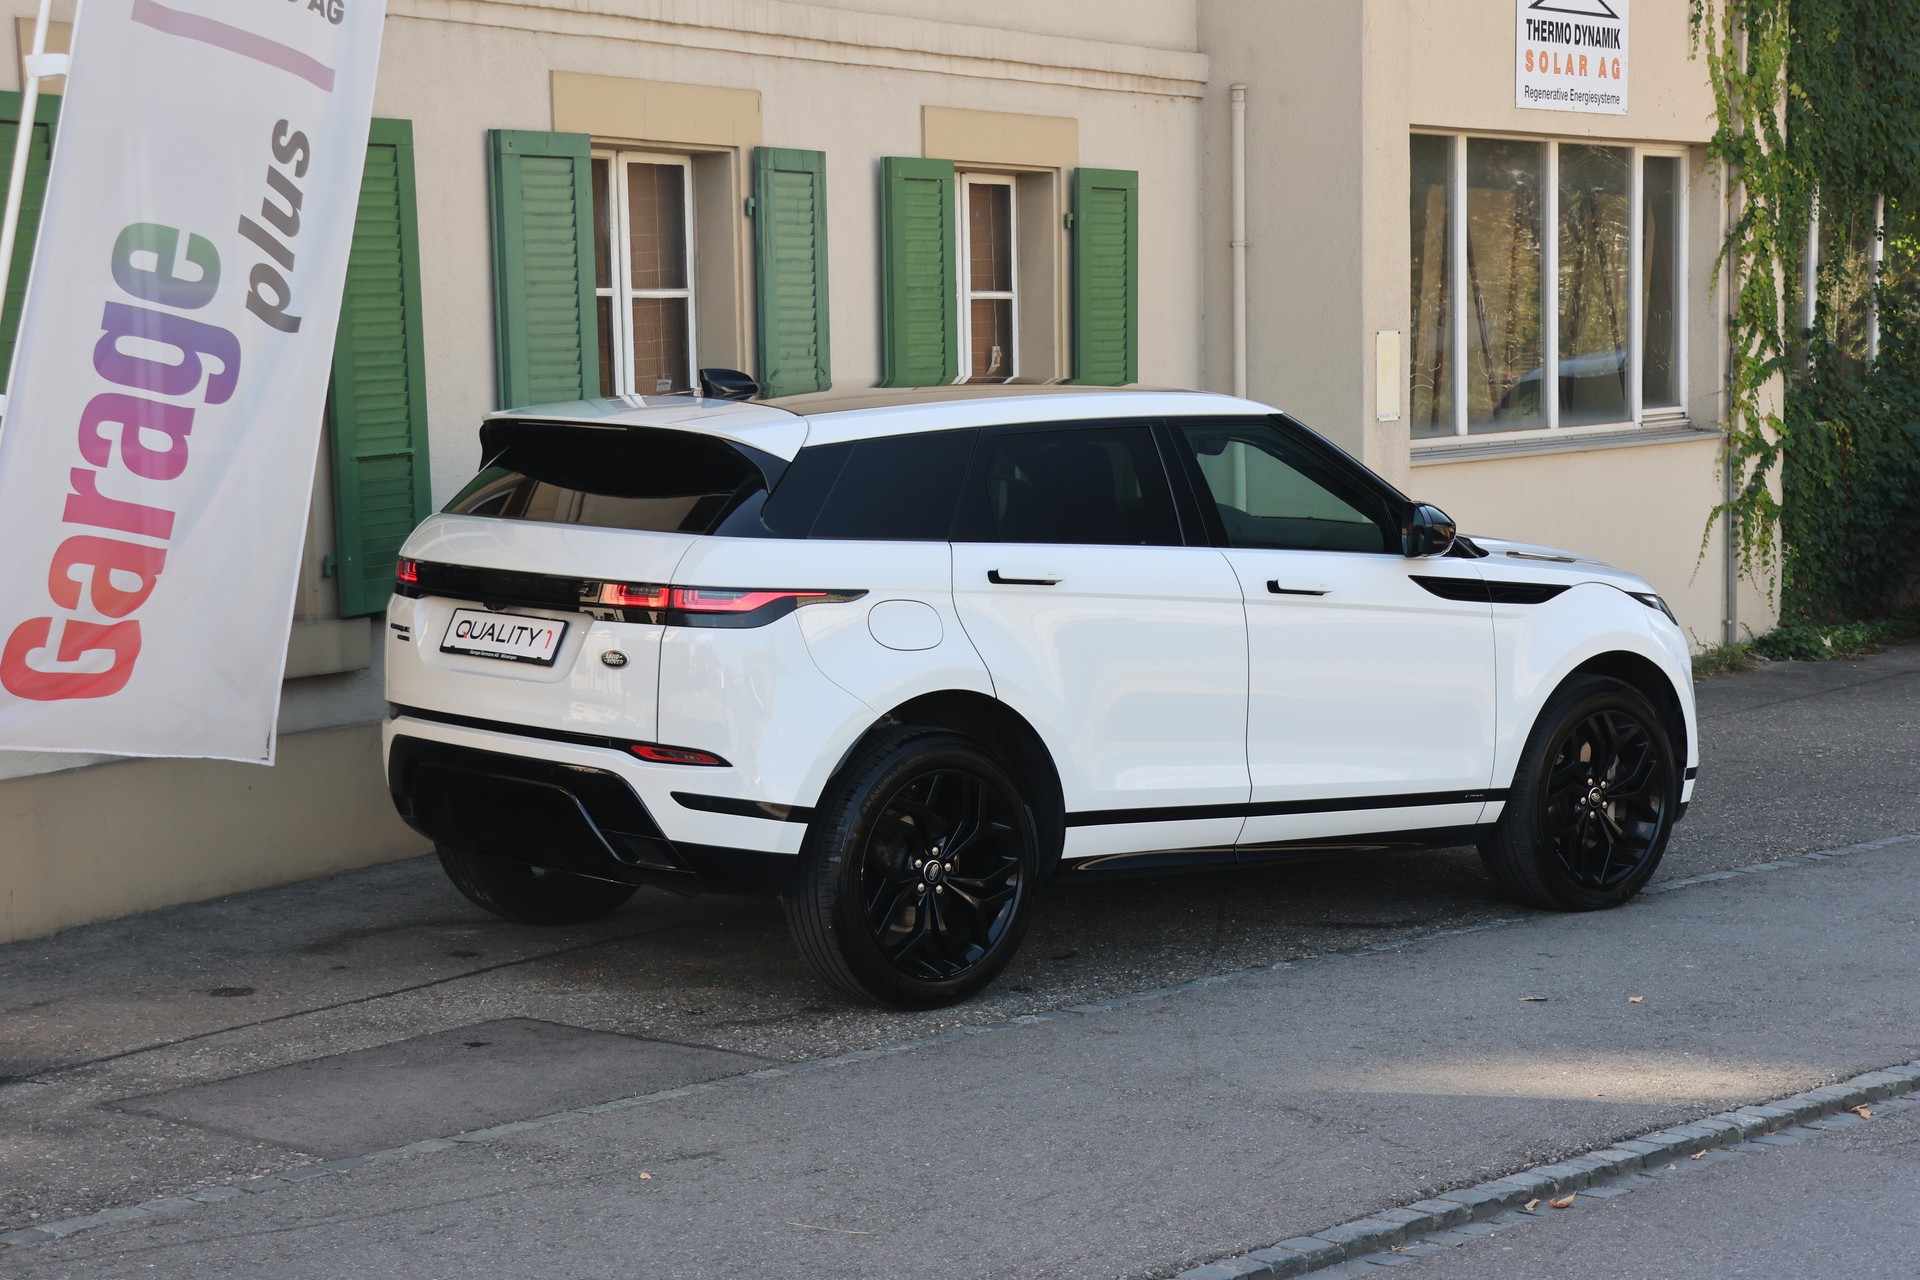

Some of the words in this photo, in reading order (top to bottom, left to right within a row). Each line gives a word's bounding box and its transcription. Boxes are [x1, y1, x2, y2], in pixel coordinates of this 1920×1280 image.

[1526, 18, 1572, 45] THERMO
[1574, 23, 1621, 50] DYNAMIK
[1525, 49, 1588, 77] SOLAR
[1598, 56, 1620, 80] AG
[1524, 85, 1569, 102] Regenerative
[1570, 88, 1620, 106] Energiesysteme
[238, 119, 311, 333] plus
[0, 222, 241, 701] Garage
[455, 619, 544, 647] QUALITY
[544, 629, 553, 649] 1
[605, 652, 620, 660] LAND
[606, 657, 624, 665] ROVER
